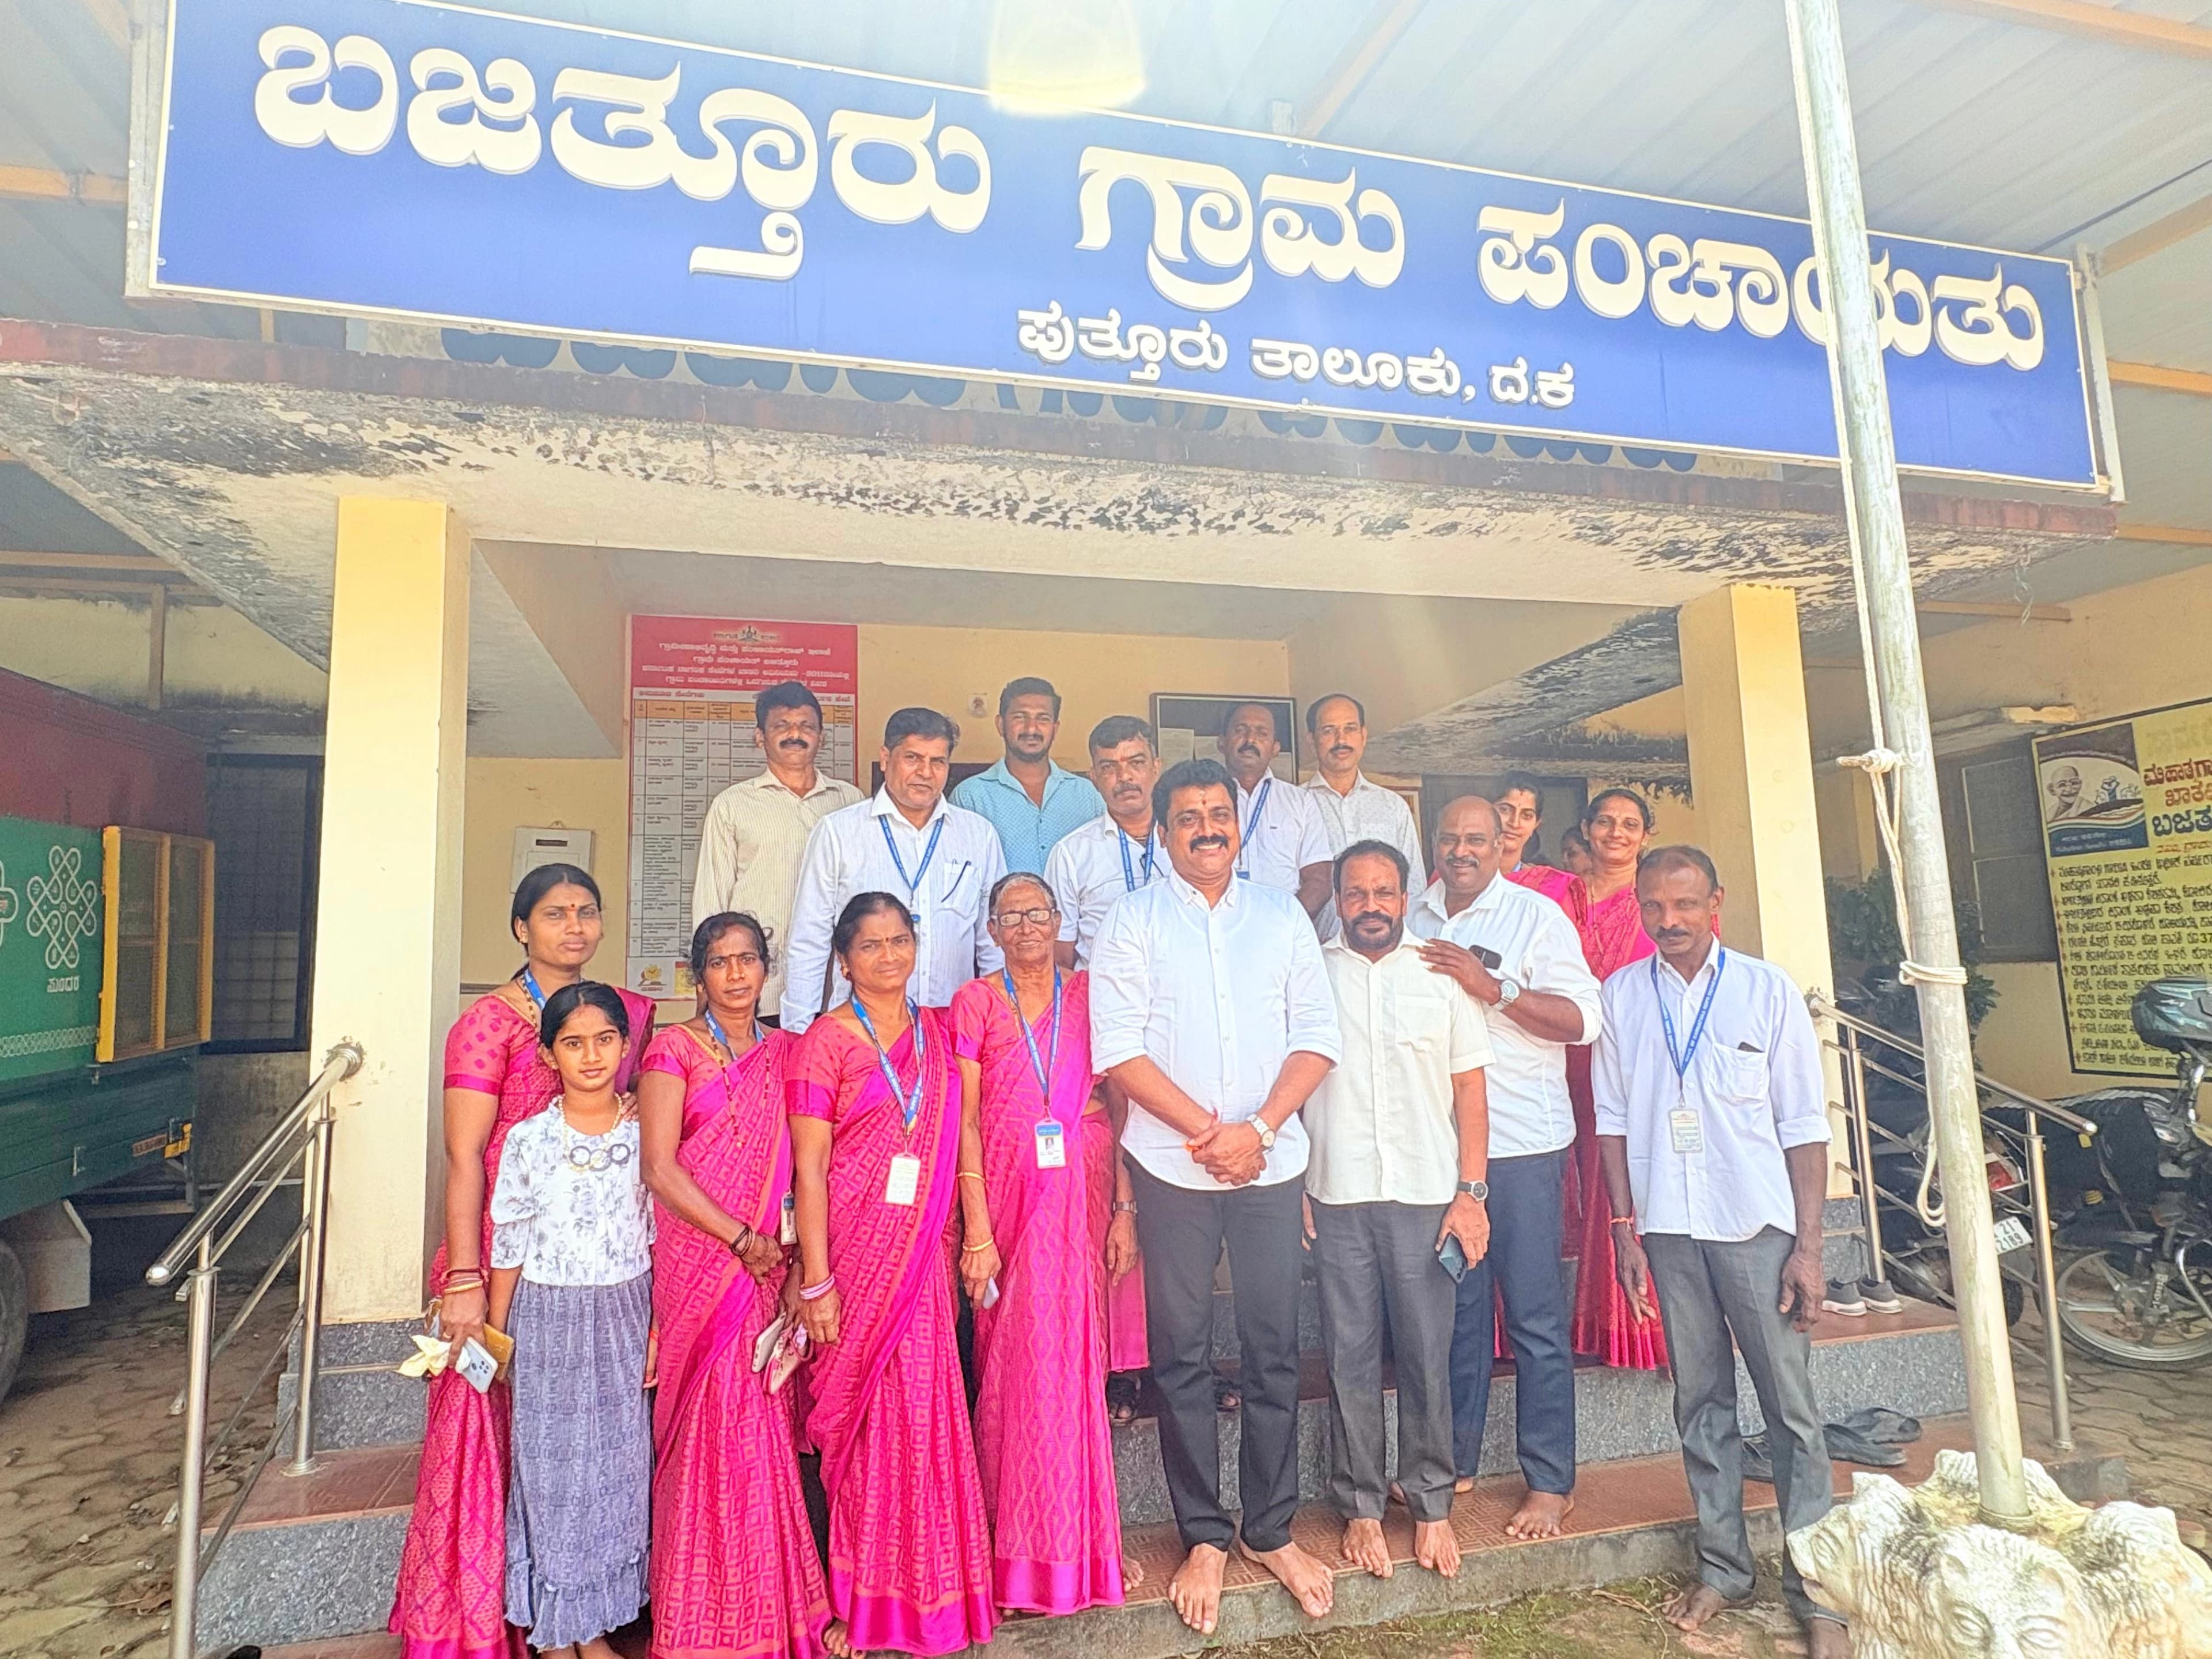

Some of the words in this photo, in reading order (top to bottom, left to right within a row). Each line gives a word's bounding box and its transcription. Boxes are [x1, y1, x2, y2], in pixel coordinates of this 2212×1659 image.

[255, 24, 991, 281] ಬಜತ್ತೂರು
[1075, 146, 1404, 312] ಗ್ರಾಮ
[1017, 300, 1228, 381] ಪುತ್ತೂರು
[1251, 338, 1476, 404] ತಾಲೂಕು,
[1490, 355, 1575, 408] ದ.ಕ
